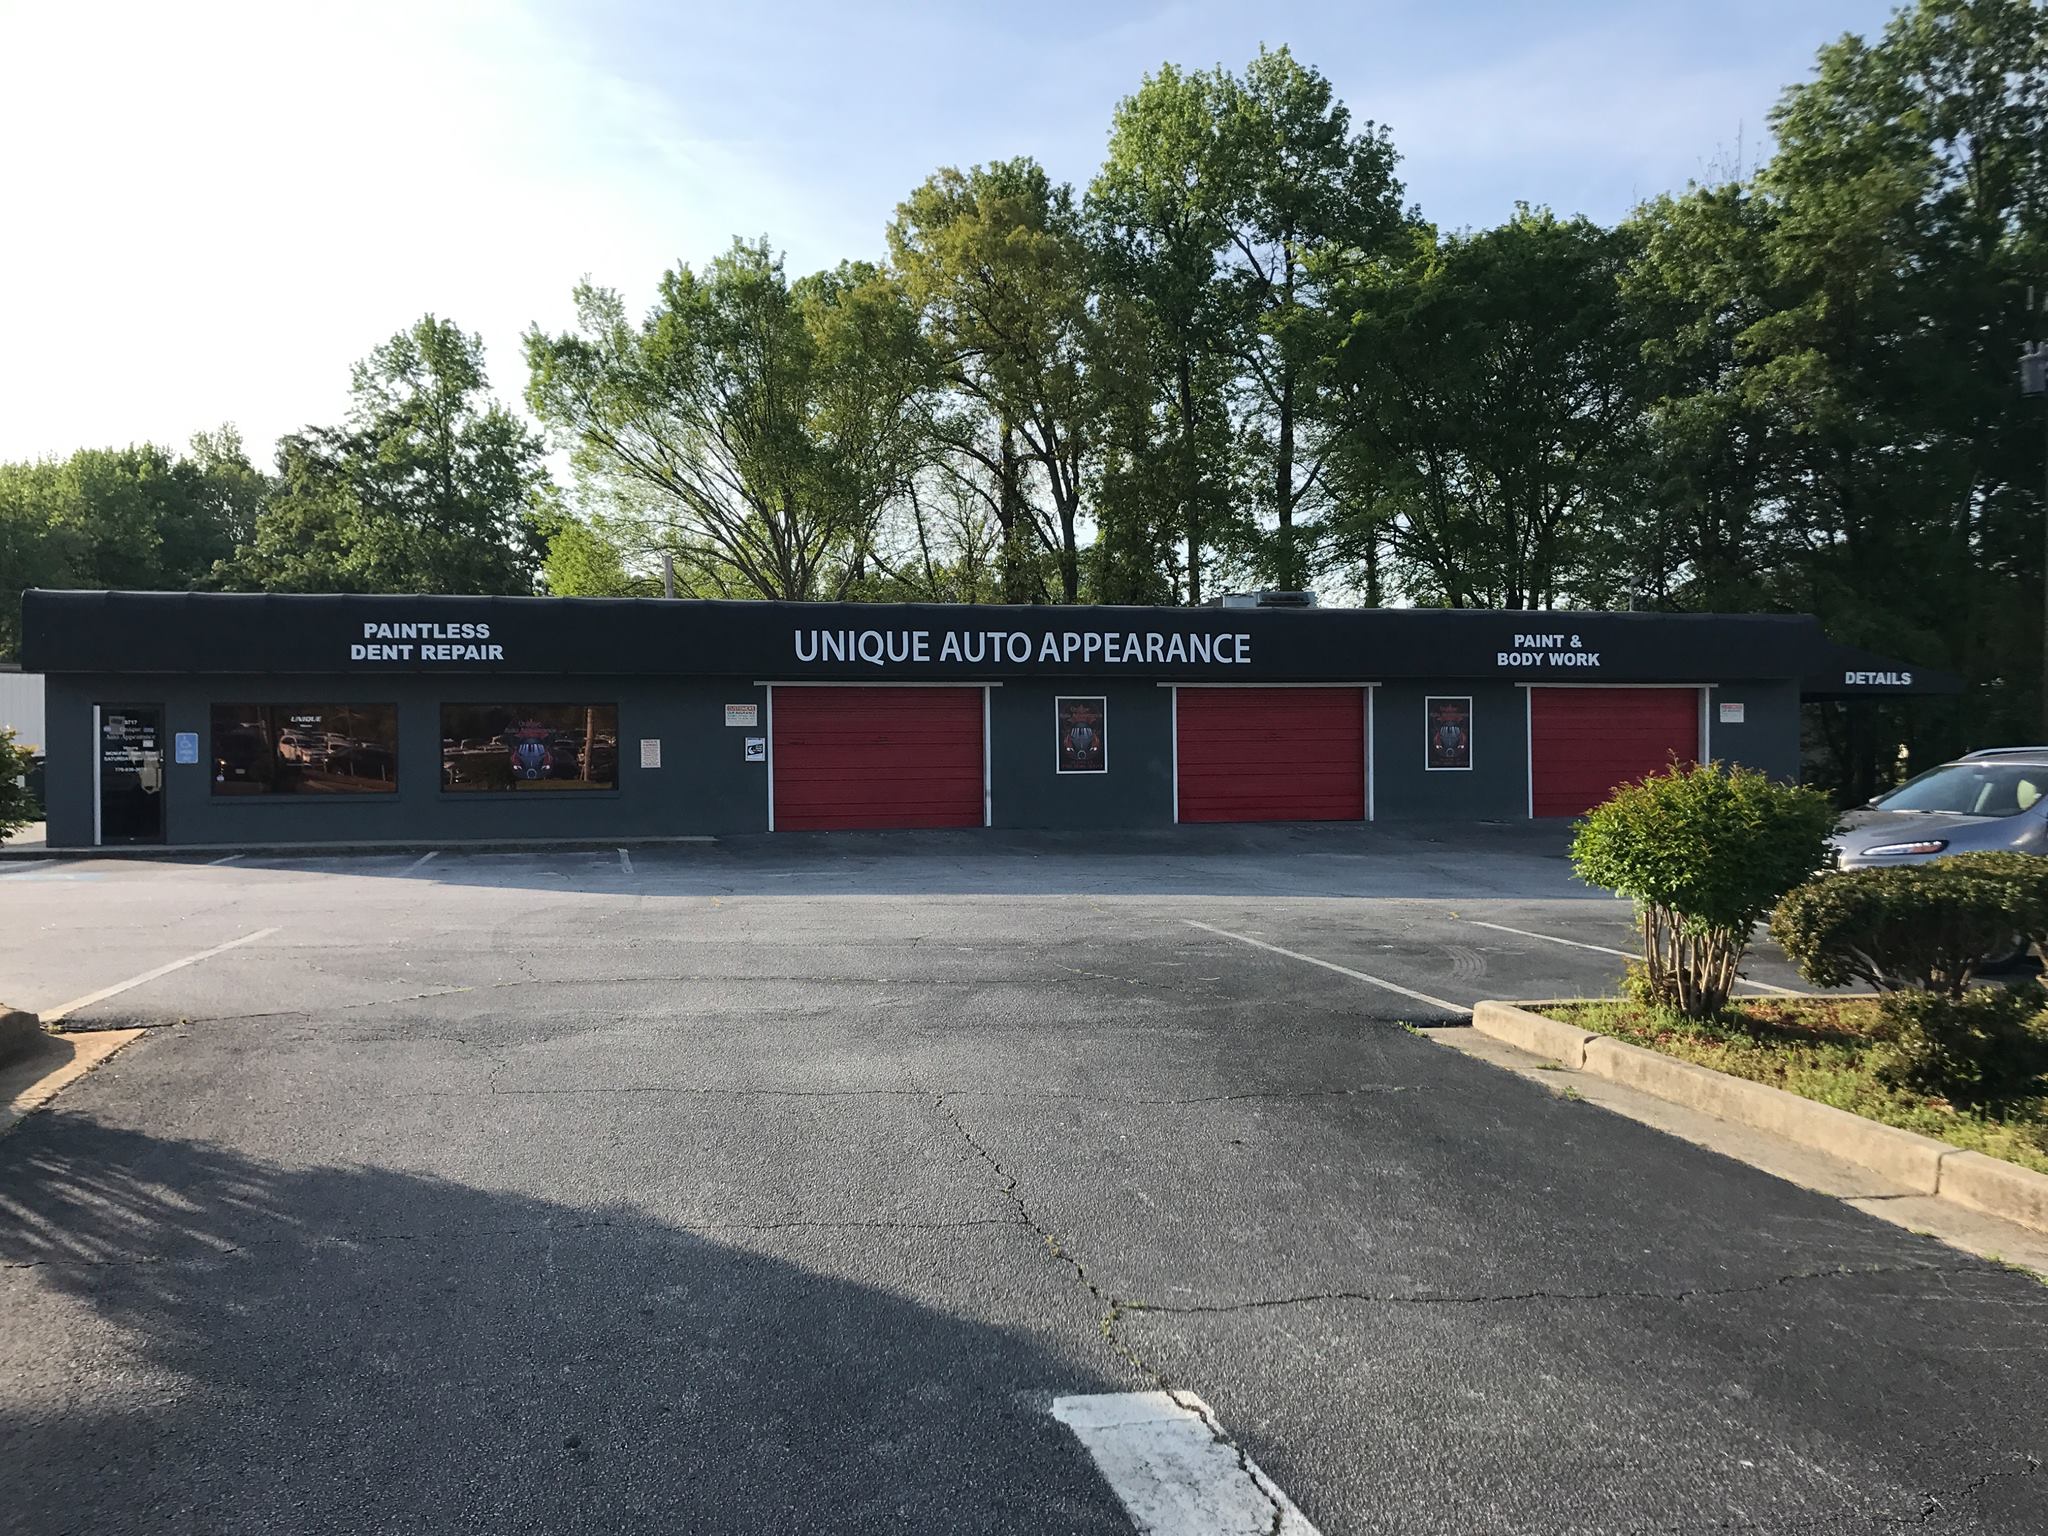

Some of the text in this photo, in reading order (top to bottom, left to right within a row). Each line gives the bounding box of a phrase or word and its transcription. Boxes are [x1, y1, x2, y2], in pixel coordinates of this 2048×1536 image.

[363, 622, 490, 639] PAINTLESS
[794, 630, 1251, 666] UNIQUE AUTO APPEARANCE
[1514, 634, 1583, 648] PAINT &
[351, 644, 504, 660] DENT REPAIR
[1497, 652, 1600, 667] BODY WORK
[1845, 671, 1912, 686] DETAILS
[290, 715, 322, 723] UNIQUE
